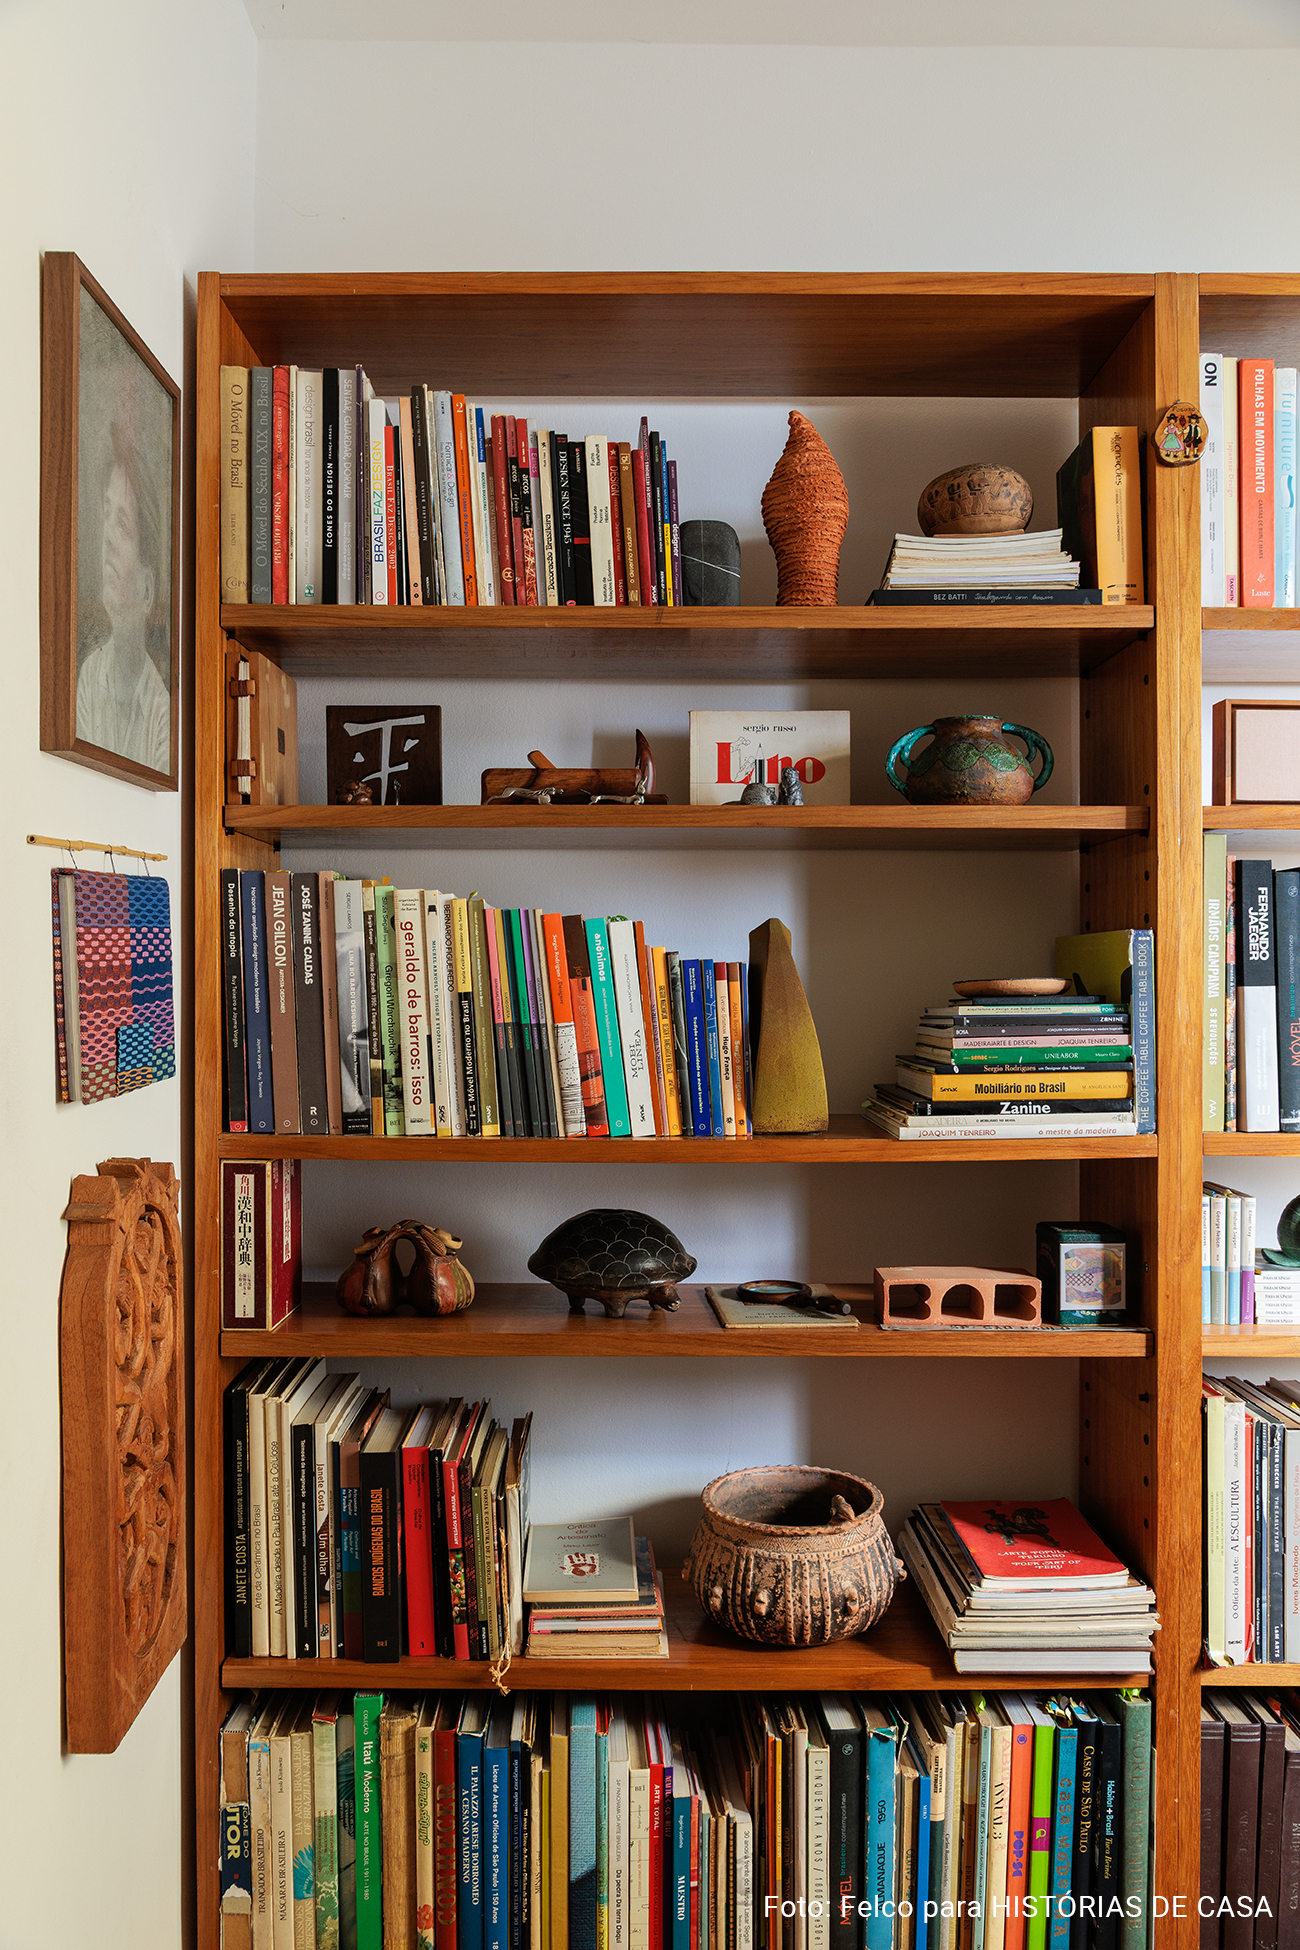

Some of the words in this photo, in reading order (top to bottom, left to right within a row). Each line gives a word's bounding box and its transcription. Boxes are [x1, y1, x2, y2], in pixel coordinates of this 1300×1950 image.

[1204, 362, 1218, 387] ON
[1255, 369, 1266, 408] FOLHAS
[231, 384, 243, 396] O
[256, 376, 269, 407] Brasil
[304, 385, 316, 419] design
[343, 379, 352, 414] SENTAR,
[230, 400, 243, 435] Móvel
[259, 411, 270, 426] no
[1255, 412, 1265, 427] EM
[1280, 392, 1296, 472] furniture
[230, 439, 240, 454] no
[256, 430, 269, 454] XIX
[304, 421, 316, 447] brasil
[343, 416, 352, 460] GUARDAR,
[230, 458, 244, 489] Brasil
[256, 458, 269, 495] Século
[559, 451, 569, 488] DESIGN
[1255, 430, 1266, 494] MOVIMENTO
[326, 462, 334, 495] DESIGN
[343, 462, 353, 499] DORMIR
[386, 465, 394, 496] BRASIL
[522, 474, 530, 494] arcos
[610, 465, 620, 496] DESIGN
[256, 498, 269, 513] do
[326, 498, 334, 512] DO
[387, 498, 395, 513] FAZ
[561, 490, 571, 520] SINCE
[255, 517, 268, 551] Móvel
[325, 514, 334, 548] ÍCONES
[387, 516, 396, 547] DESIGN
[544, 514, 553, 551] Brasileira
[563, 523, 572, 545] 1945
[672, 524, 680, 557] designer
[256, 556, 268, 567] O
[388, 549, 396, 570] 2002
[546, 551, 556, 591] Decoração
[933, 593, 947, 601] BEZ
[948, 593, 968, 601] BATTI
[743, 723, 769, 734] sergio
[227, 883, 236, 918] Desenho
[250, 887, 258, 914] Horizonte
[272, 885, 285, 918] JEAN
[300, 885, 313, 909] JOSÉ
[228, 919, 236, 930] da
[250, 914, 260, 942] ampliado
[302, 911, 313, 945] ZANINE
[1208, 899, 1222, 942] IRMÃOS
[1248, 907, 1259, 961] JAEGER
[1258, 887, 1270, 961] FERNANDO
[228, 931, 237, 958] utopia
[251, 942, 260, 961] design
[273, 920, 287, 967] GILLON
[401, 921, 421, 983] geraldo
[552, 934, 560, 951] Sergio
[594, 933, 608, 982] anônimos
[1138, 943, 1148, 967] BOOK
[252, 961, 260, 987] moderno
[303, 946, 314, 985] CALDAS
[348, 966, 355, 975] BO
[553, 952, 563, 978] Rodrigues
[1208, 944, 1220, 998] CAMPANA
[384, 964, 395, 998] Gregori
[1139, 970, 1148, 998] TABLE
[253, 988, 261, 1014] brasileiro
[407, 989, 423, 1009] de
[461, 1000, 471, 1023] Brasil
[1208, 1007, 1218, 1018] 35
[386, 999, 398, 1057] Warchavchik
[464, 1024, 472, 1036] no
[1139, 1000, 1148, 1036] COFFEE
[409, 1015, 425, 1070] barros:
[463, 1037, 475, 1076] Moderno
[633, 1029, 644, 1071] LINEA
[721, 1036, 730, 1055] Hugo
[733, 1040, 742, 1063] Sergio
[1044, 1052, 1079, 1060] UNILABOR
[1140, 1038, 1149, 1066] TABLE
[1208, 1019, 1218, 1066] REVOLUÇÕES
[628, 1044, 639, 1079] MOBI
[722, 1057, 732, 1080] França
[411, 1076, 425, 1106] isso
[465, 1077, 475, 1102] Móvel
[735, 1065, 744, 1102] Rodrigues
[974, 1082, 1023, 1095] Mobiliário
[1024, 1085, 1037, 1095] no
[1039, 1082, 1066, 1094] Brasil
[1140, 1069, 1149, 1104] COFFEE
[926, 1116, 968, 1126] CADEIRA
[999, 1101, 1051, 1114] Zanine
[1140, 1106, 1149, 1124] THE
[918, 1128, 957, 1138] JOAQUIM
[958, 1128, 997, 1137] TENREIRO
[269, 1441, 279, 1475] Celulose
[270, 1484, 280, 1497] até
[316, 1462, 325, 1489] Janete
[252, 1504, 261, 1527] Brasil
[317, 1490, 326, 1512] Costa
[370, 1487, 383, 1514] BRASIL
[1230, 1479, 1240, 1541] ESCULTURA
[271, 1499, 281, 1539] Pau-Brasil
[371, 1514, 384, 1525] DO
[235, 1533, 247, 1566] COSTA
[254, 1528, 261, 1541] no
[318, 1532, 328, 1548] Um
[368, 1526, 385, 1566] INDÍGENAS
[252, 1542, 262, 1580] Cerâmica
[272, 1548, 282, 1573] desde
[319, 1549, 329, 1575] olhar
[1291, 1545, 1299, 1588] Machado
[236, 1568, 247, 1605] JANETE
[253, 1581, 262, 1592] da
[273, 1575, 283, 1607] Madeira
[371, 1567, 385, 1596] BANCOS
[254, 1592, 262, 1610] Arte
[274, 1608, 283, 1616] A
[363, 1740, 374, 1765] Itaú
[1083, 1745, 1095, 1777] CASAS
[1129, 1727, 1146, 1802] WORLD
[470, 1765, 480, 1776] IL
[363, 1770, 373, 1813] Moderno
[418, 1771, 431, 1809] Plantas
[470, 1776, 480, 1819] PALAZZO
[814, 1759, 824, 1827] CINQUENTA
[1082, 1780, 1092, 1794] DE
[877, 1799, 886, 1825] 1950
[1081, 1797, 1093, 1817] SÃO
[417, 1809, 431, 1847] Minhas
[470, 1820, 480, 1851] ARESE
[1080, 1820, 1092, 1853] PAULO
[435, 1782, 456, 1926] CONHECER
[814, 1834, 824, 1863] ANOS
[470, 1852, 480, 1905] BORROMEO
[677, 1875, 686, 1920] MAESTRO
